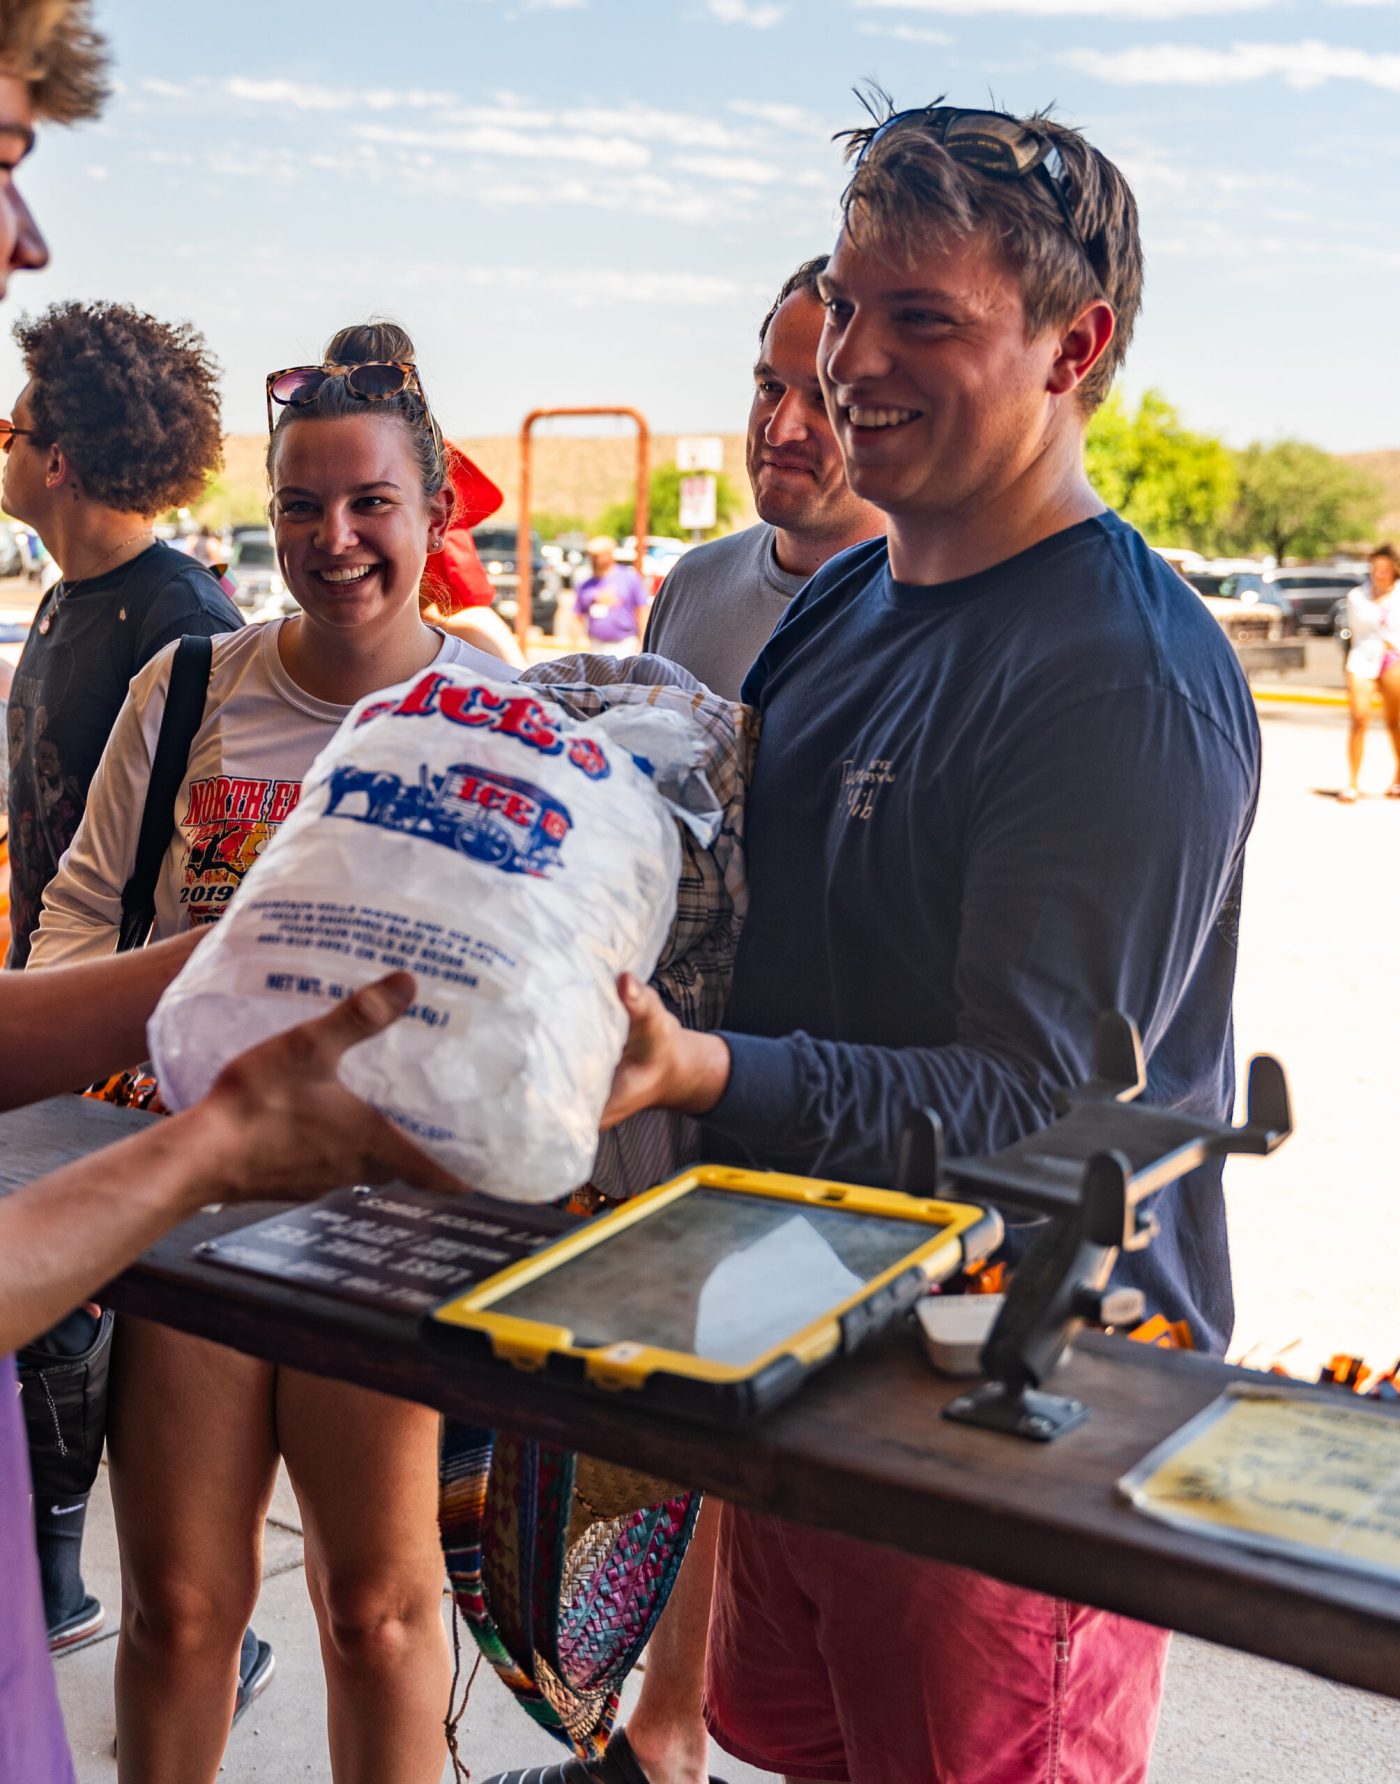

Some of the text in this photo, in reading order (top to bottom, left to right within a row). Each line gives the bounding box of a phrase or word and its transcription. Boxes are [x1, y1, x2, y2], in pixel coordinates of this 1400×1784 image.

[390, 671, 564, 756] ICE
[181, 775, 304, 826] NORTH EA
[458, 776, 534, 827] ICE
[180, 885, 235, 904] 2019
[264, 972, 293, 993] NET
